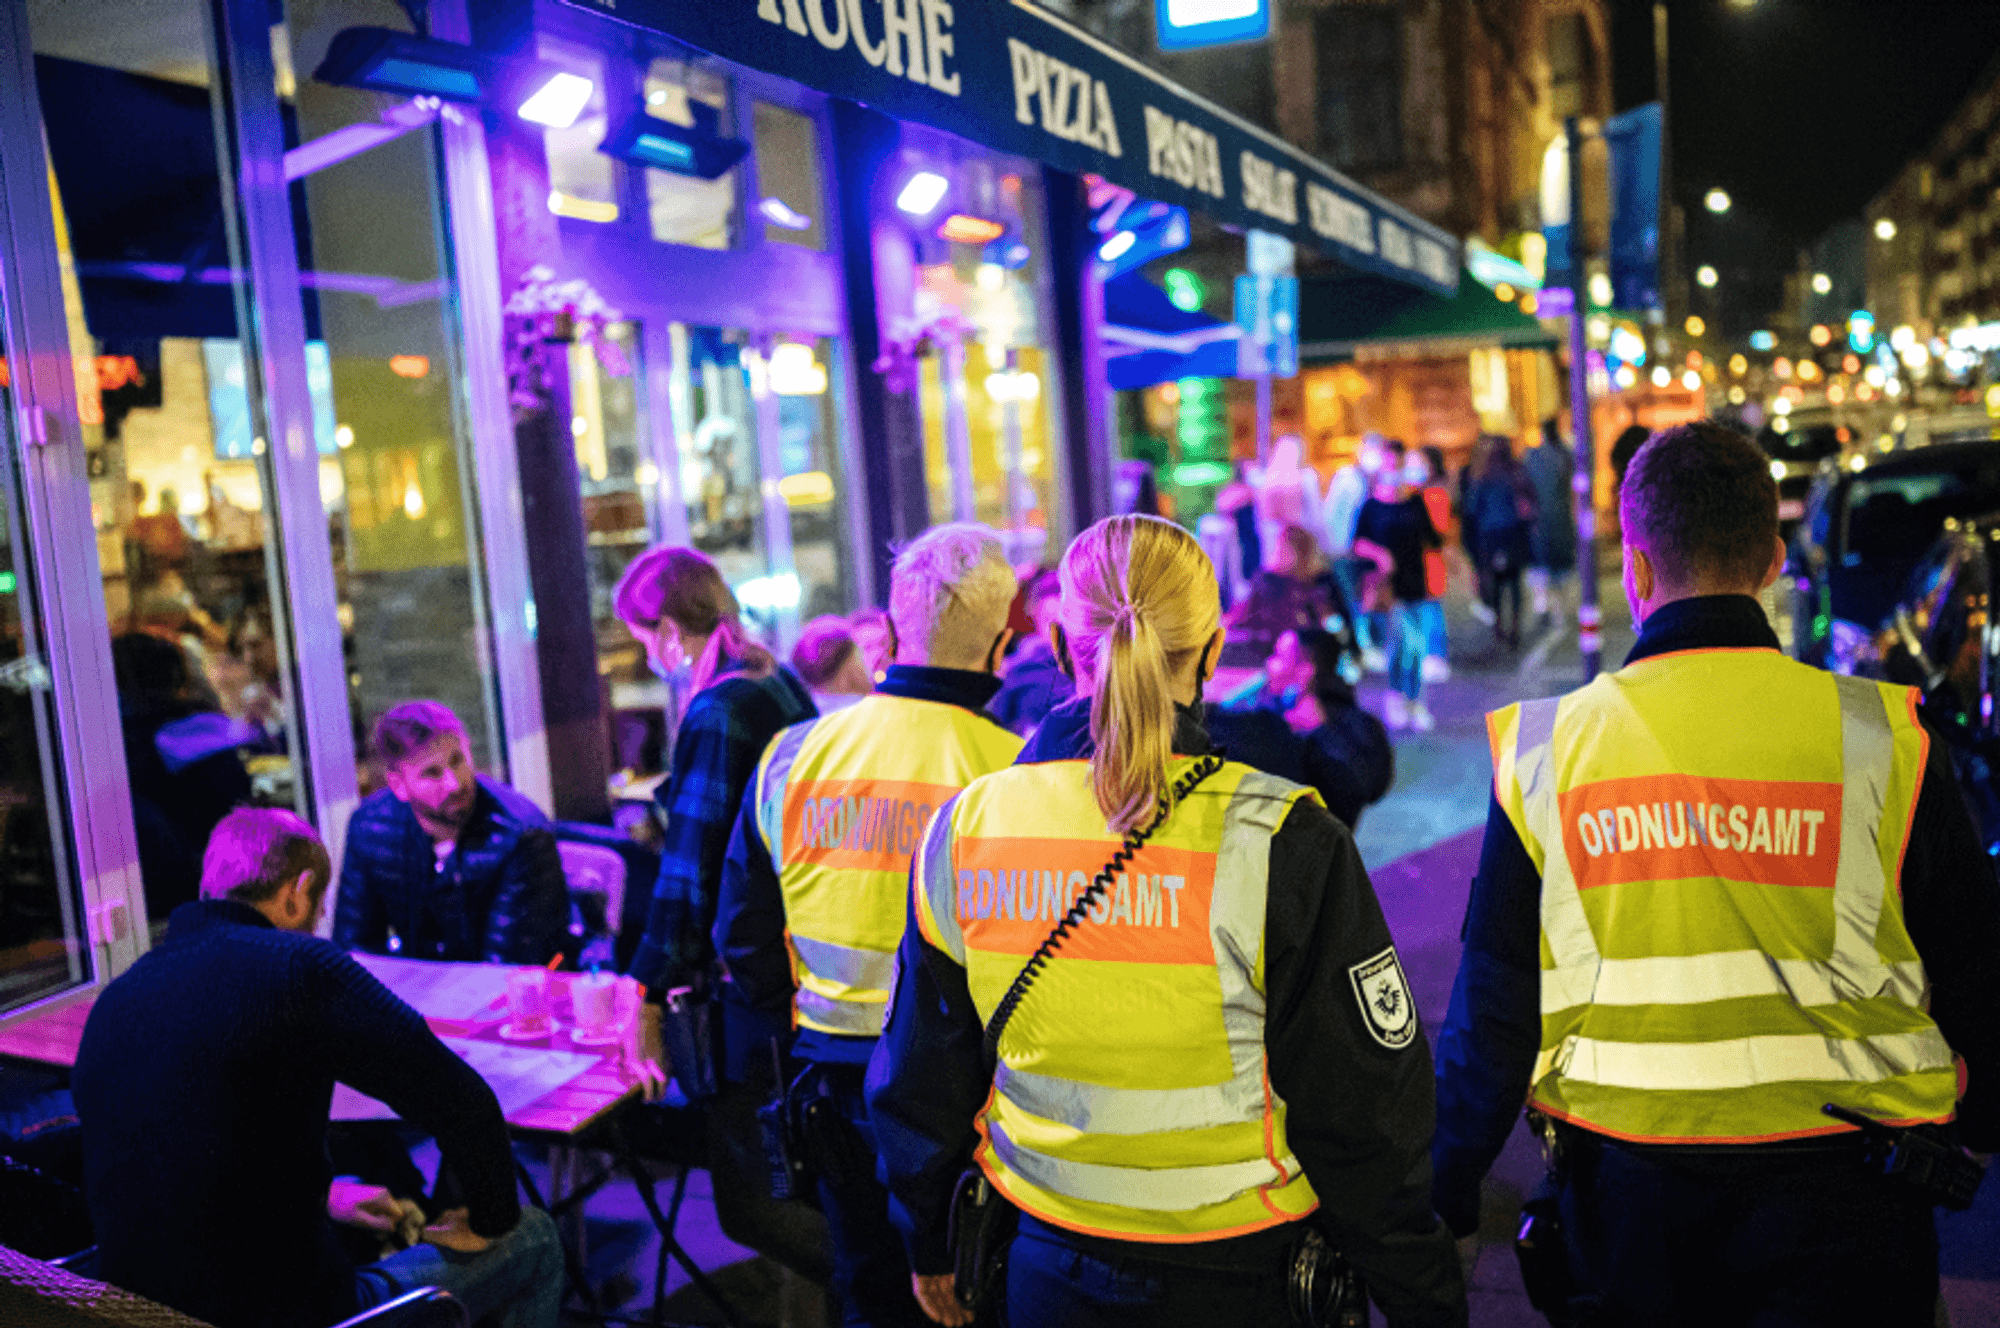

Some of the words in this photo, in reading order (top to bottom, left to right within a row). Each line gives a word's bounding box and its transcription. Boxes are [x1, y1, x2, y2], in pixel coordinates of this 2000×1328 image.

[1008, 38, 1122, 158] PIZZA
[1144, 106, 1225, 199] PASTA
[1577, 801, 1825, 857] ORDNUNGSAMT
